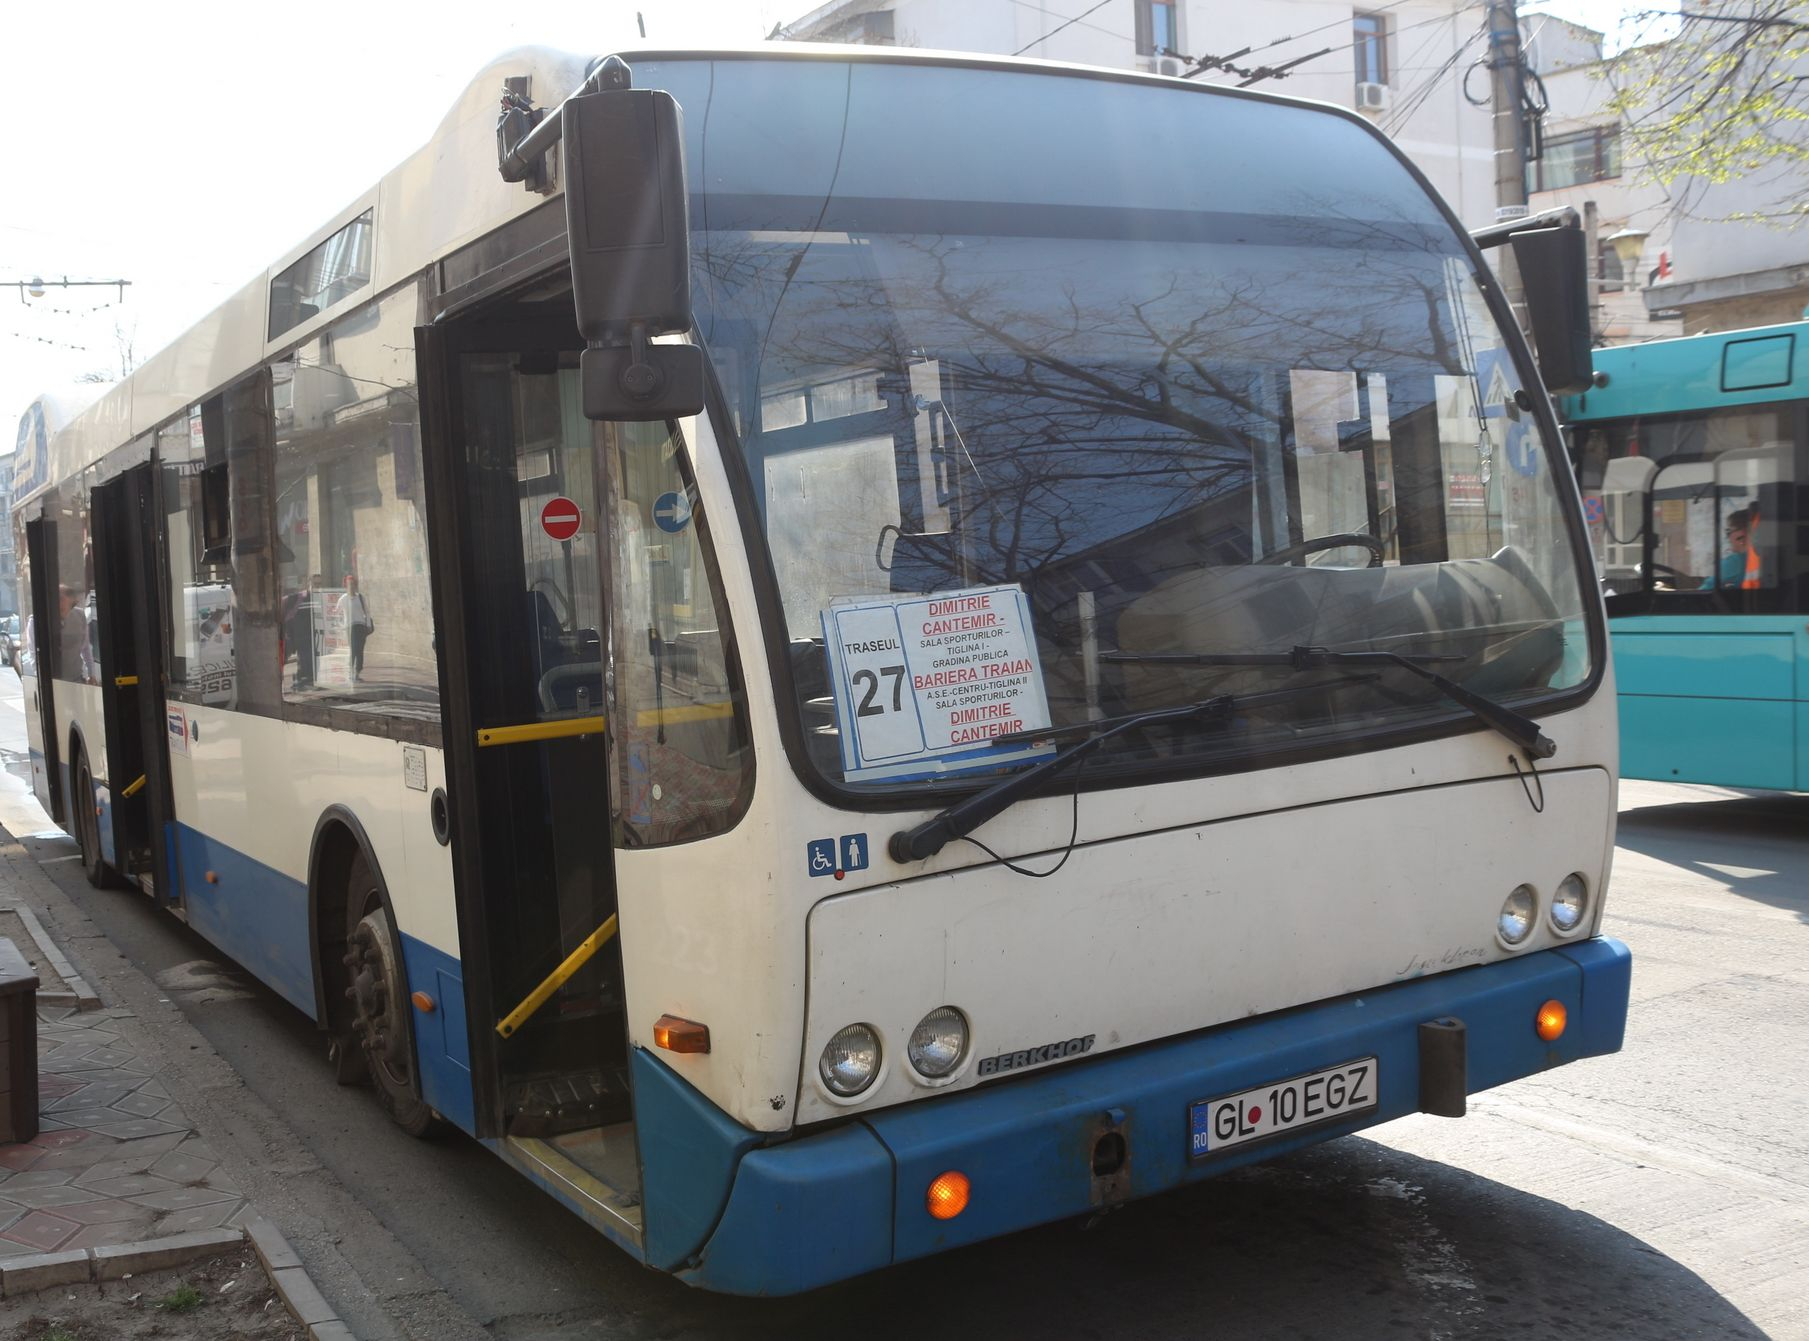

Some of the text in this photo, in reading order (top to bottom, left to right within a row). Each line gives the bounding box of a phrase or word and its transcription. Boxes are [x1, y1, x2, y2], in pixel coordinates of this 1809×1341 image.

[929, 596, 990, 616] DIMITRIE
[922, 613, 997, 636] CANTEMIR
[845, 638, 900, 655] TRASEUL
[920, 638, 942, 649] SALA
[944, 628, 1003, 645] SPORTURILOR
[947, 643, 980, 655] TIGLINA
[932, 649, 1008, 669] GRADINA PUBLICA
[914, 667, 978, 689] BARIERA
[852, 664, 906, 718] 27
[936, 699, 958, 710] SALA
[959, 688, 1018, 706] SPORTURILOR
[950, 702, 1012, 725] DIMITRIE
[950, 719, 1023, 743] CANTEMIR
[978, 1033, 1096, 1076] BERKHOF
[1215, 1065, 1368, 1141] GL 10 EGZ
[1193, 1131, 1207, 1150] RO
